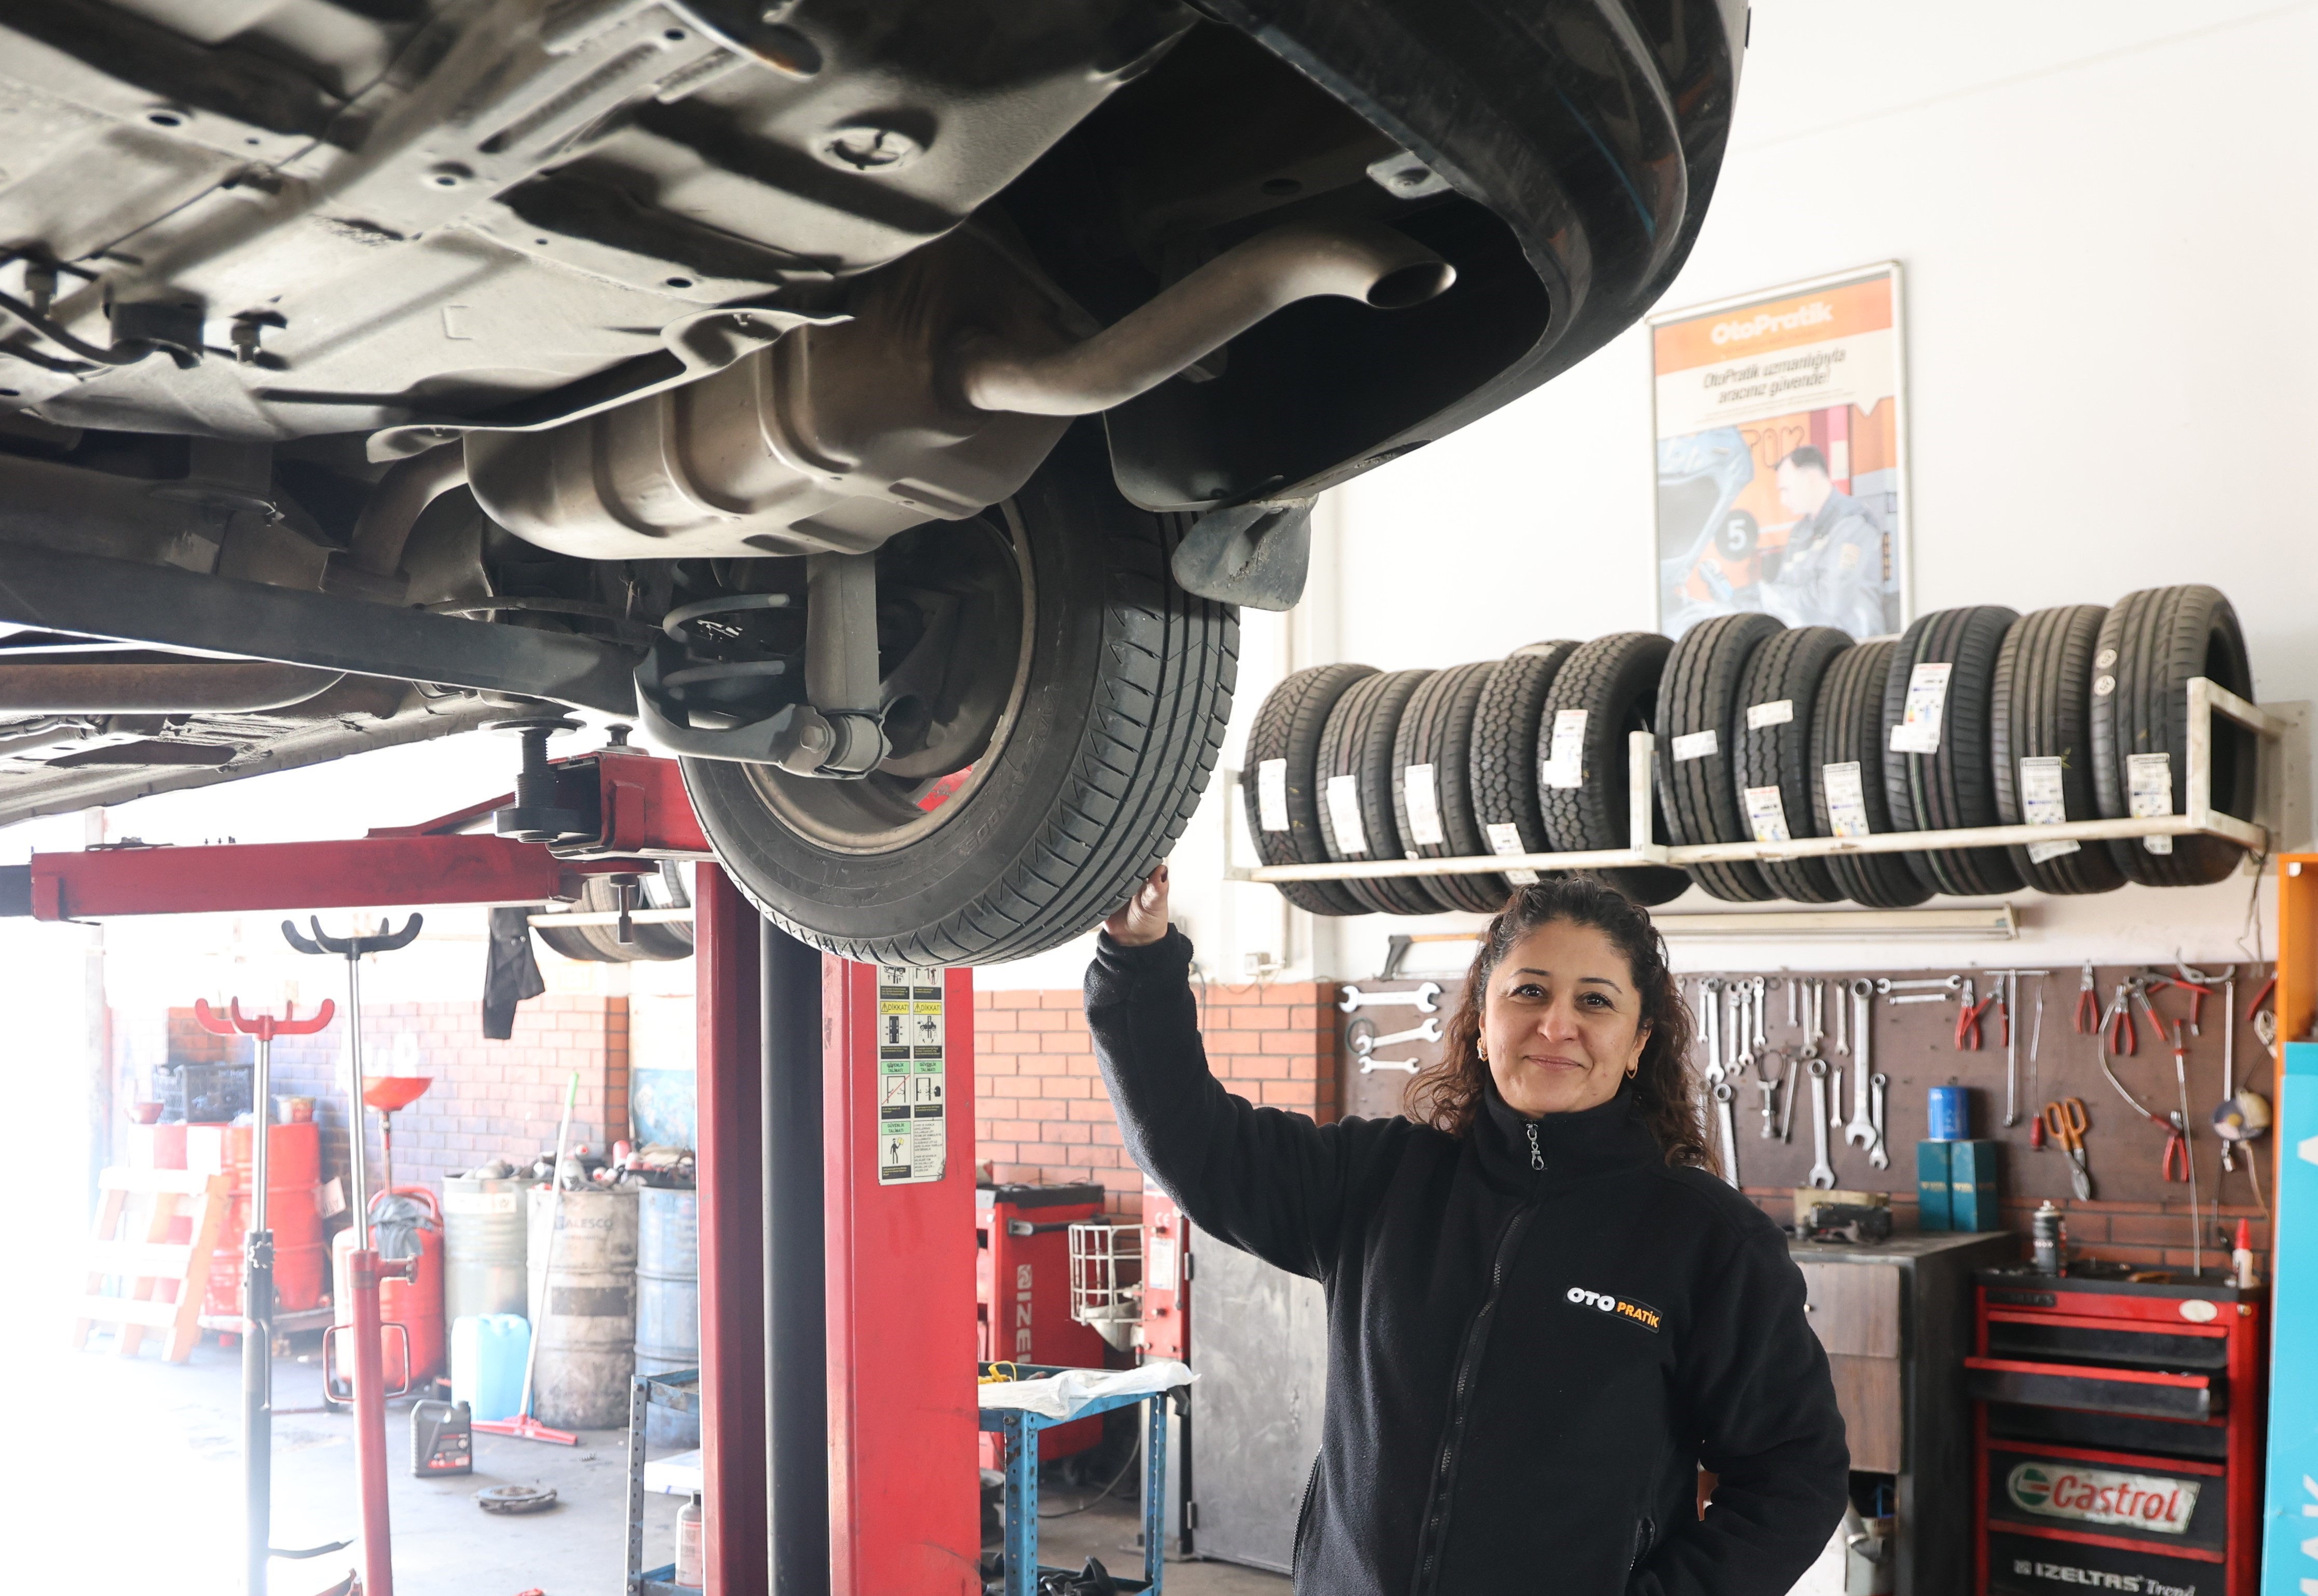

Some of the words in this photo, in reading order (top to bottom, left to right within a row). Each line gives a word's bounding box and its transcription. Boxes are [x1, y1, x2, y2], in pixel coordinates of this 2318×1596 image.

[1711, 301, 1834, 345] OtoPratik
[1703, 363, 1760, 389] OtoPratik
[1727, 519, 1748, 551] 5
[921, 1003, 941, 1012] DİKKAT!
[1567, 1287, 1616, 1312] OTO
[1616, 1301, 1660, 1328] PRATİK
[2053, 1475, 2180, 1522] Castrol
